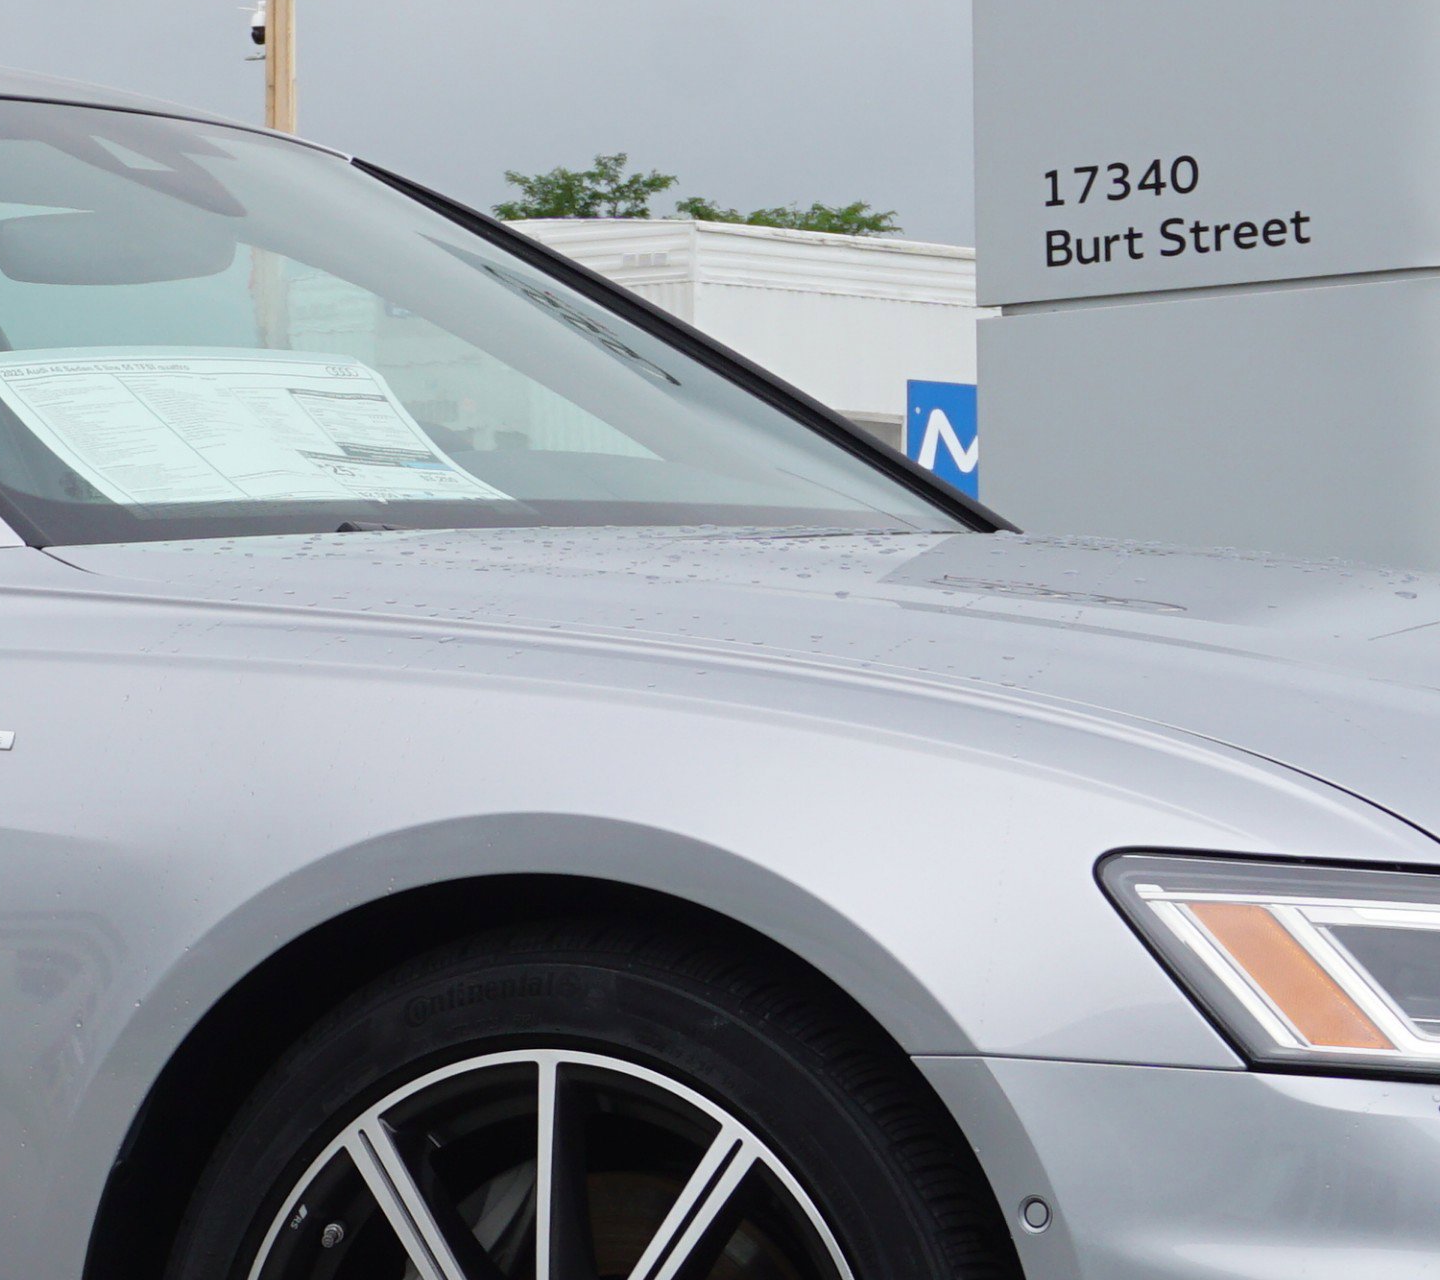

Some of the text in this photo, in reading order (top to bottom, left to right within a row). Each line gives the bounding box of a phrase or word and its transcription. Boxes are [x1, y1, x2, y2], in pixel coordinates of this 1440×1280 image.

[1044, 155, 1200, 207] 17340
[1046, 211, 1311, 267] Burt Street
